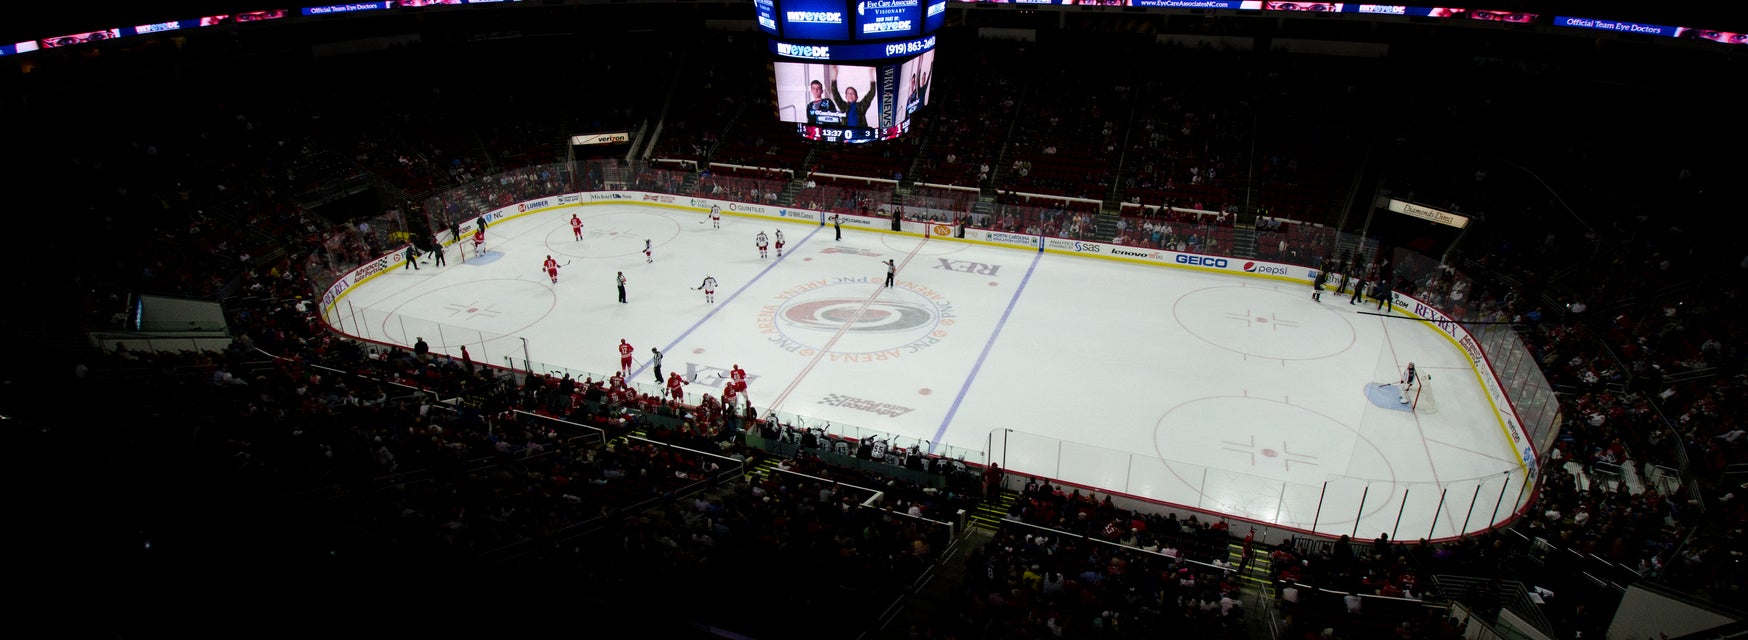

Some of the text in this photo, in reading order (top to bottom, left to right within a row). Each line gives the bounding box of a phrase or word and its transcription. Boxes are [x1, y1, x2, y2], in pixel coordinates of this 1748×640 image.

[311, 3, 378, 14] Official Team Eye Doctors
[867, 0, 878, 8] Eye
[878, 0, 891, 8] Care
[1567, 17, 1661, 34] Official Team Eye Doctors
[886, 43, 907, 57] (919)
[883, 95, 893, 128] NEWS
[814, 127, 821, 137] 1
[822, 129, 842, 137] 13:37
[844, 129, 853, 140] 0
[526, 200, 549, 210] LUMBER
[737, 205, 765, 214] QUINTILES
[493, 211, 504, 219] NC
[1403, 204, 1454, 223] Diamonds Direct
[1082, 244, 1100, 253] sas
[1111, 248, 1148, 258] lenovo
[1176, 254, 1228, 268] GEICO
[931, 257, 1003, 277] REX
[1258, 265, 1288, 276] pepsi
[335, 278, 350, 297] REX
[1414, 302, 1458, 338] REX REX
[842, 402, 904, 418] Advance
